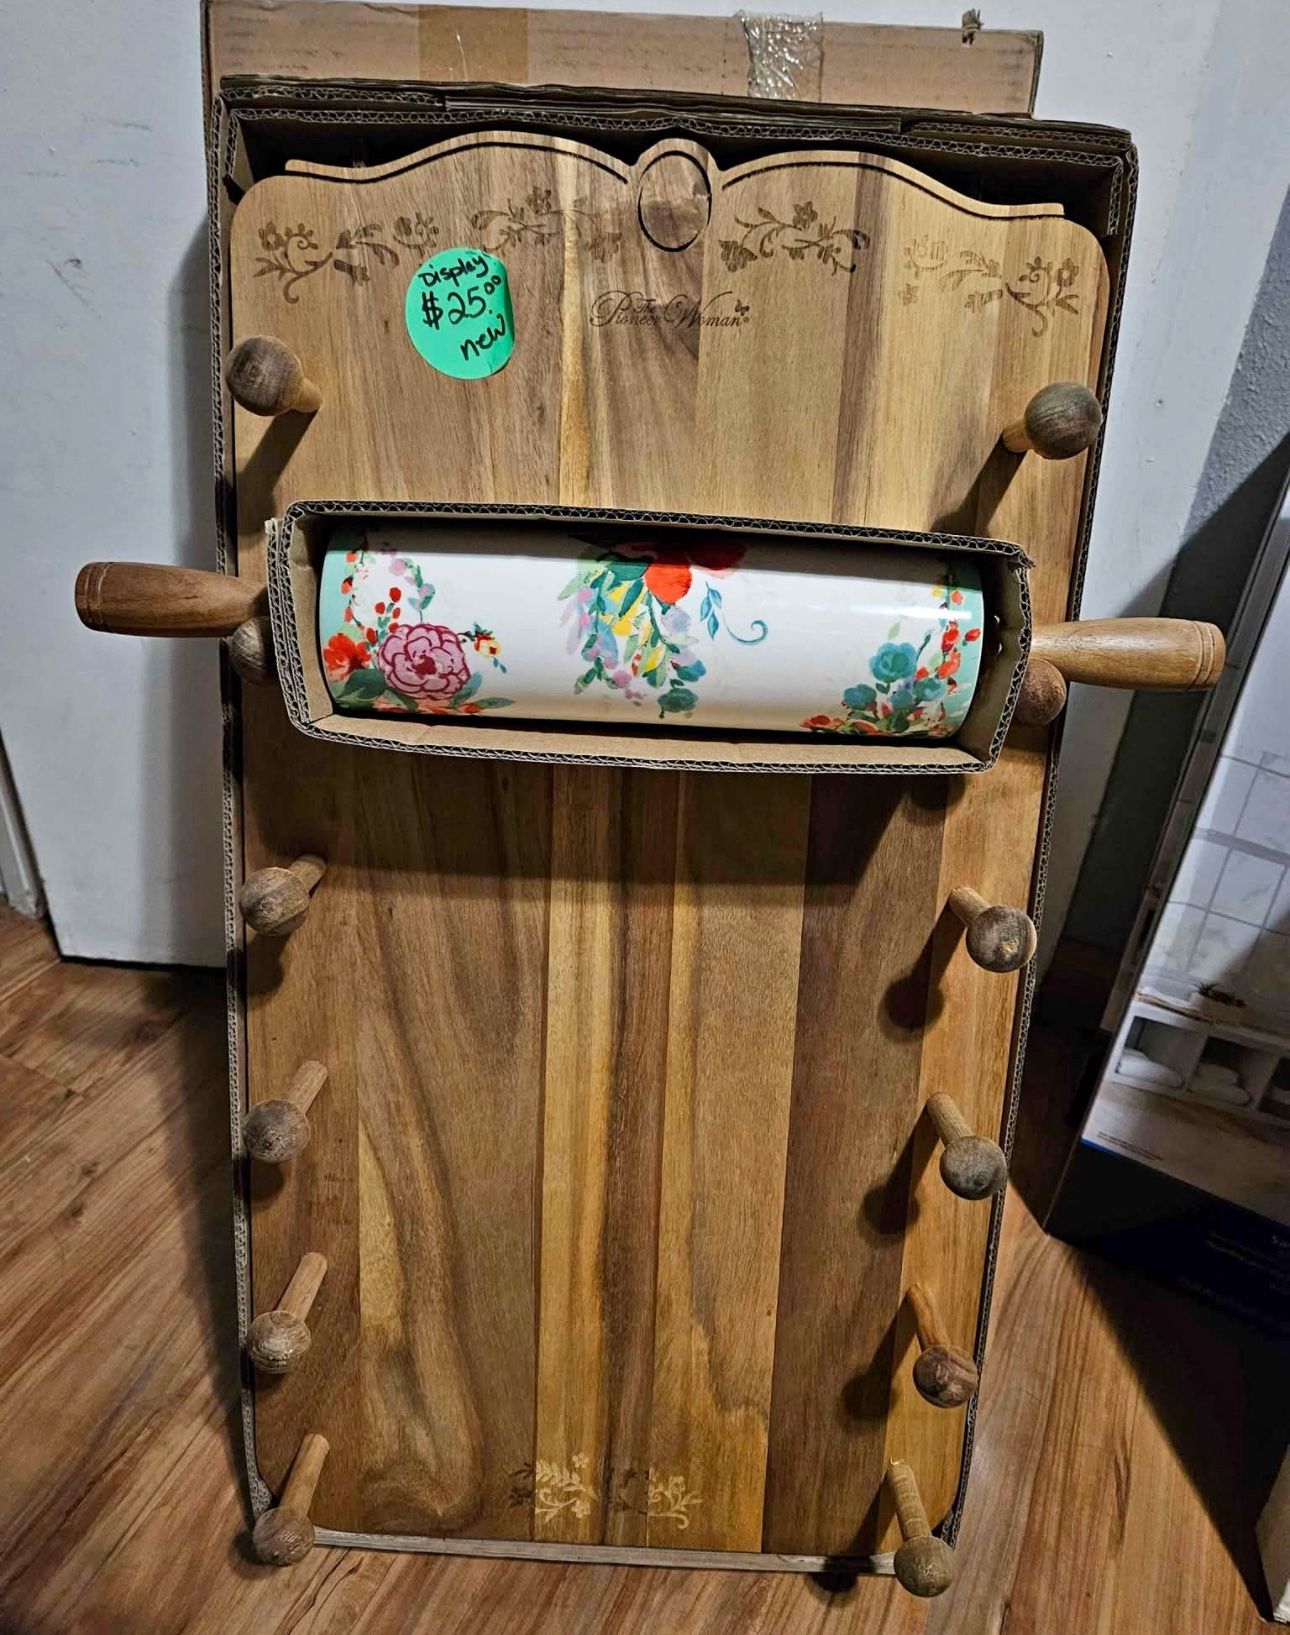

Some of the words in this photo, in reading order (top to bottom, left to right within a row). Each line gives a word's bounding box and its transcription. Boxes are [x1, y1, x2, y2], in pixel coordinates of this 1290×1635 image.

[418, 256, 489, 287] Display
[589, 290, 662, 328] Pioneer
[663, 290, 742, 329] Woman
[632, 298, 657, 313] The
